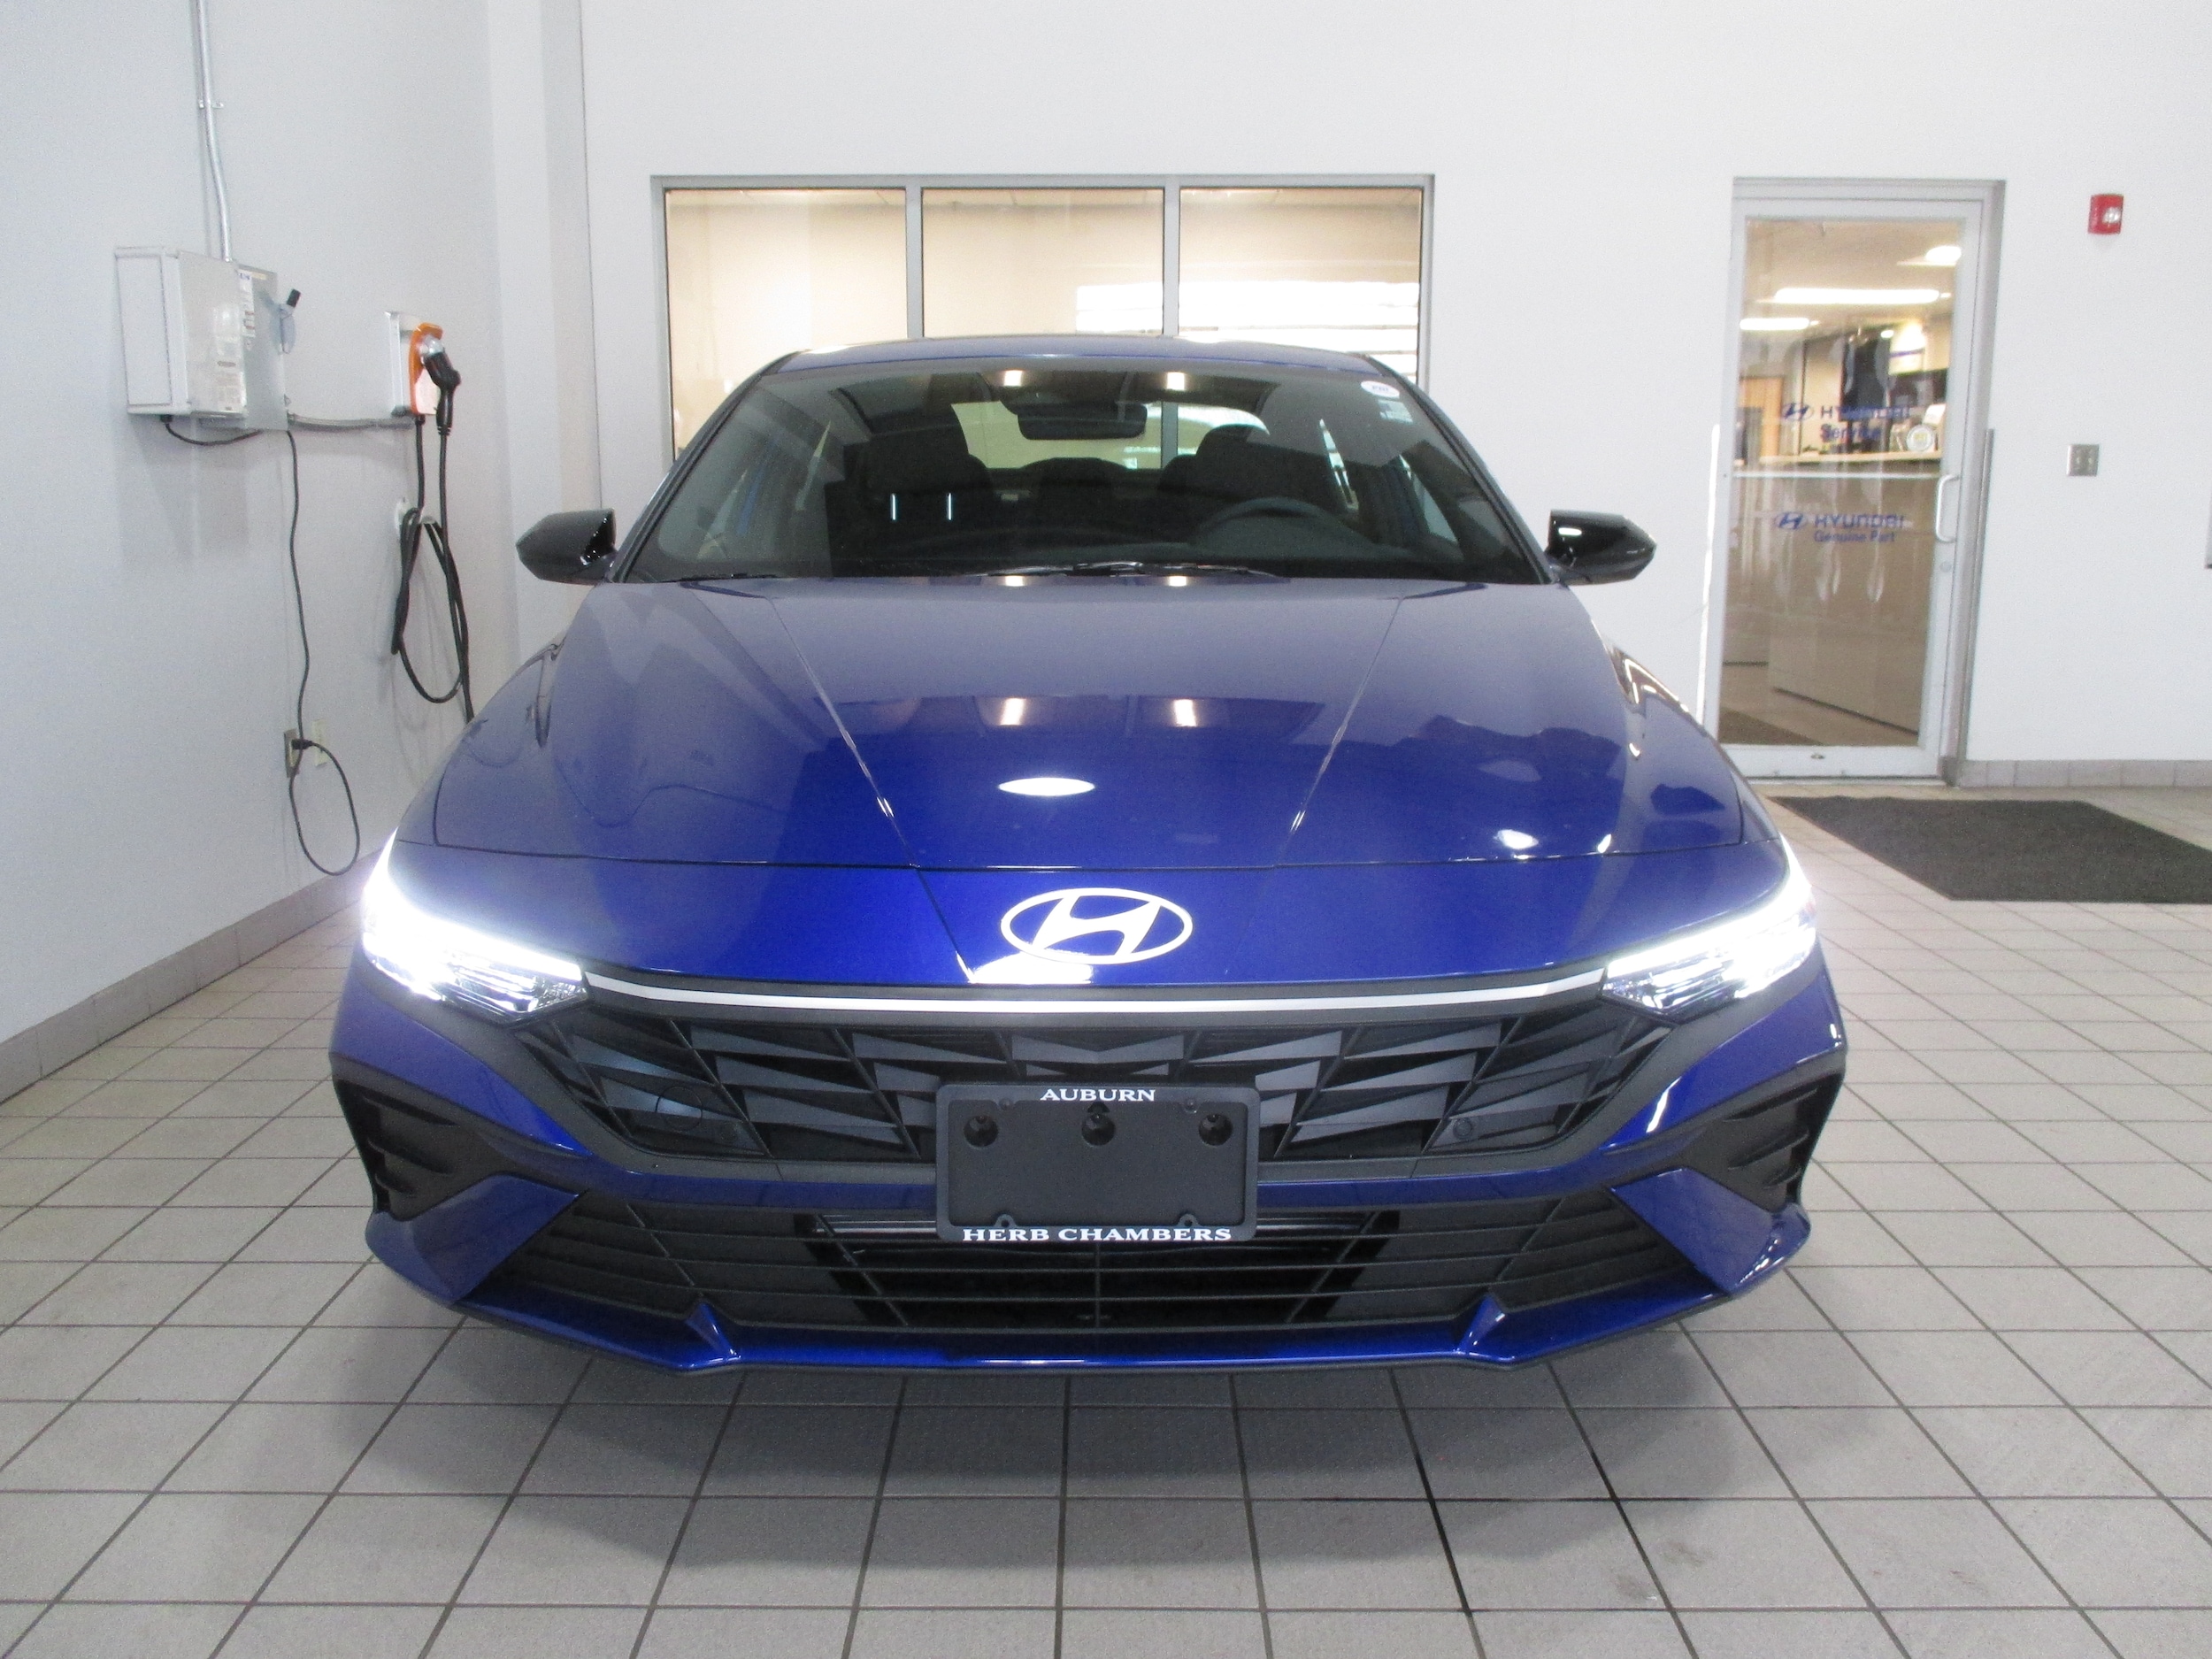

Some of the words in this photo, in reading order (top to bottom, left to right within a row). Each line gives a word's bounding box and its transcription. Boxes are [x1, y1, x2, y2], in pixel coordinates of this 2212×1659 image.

[1816, 513, 1904, 528] HYUNDAI
[1040, 1088, 1156, 1102] AUBURN
[963, 1228, 1049, 1241] HERB
[1057, 1227, 1232, 1241] CHAMBERS
